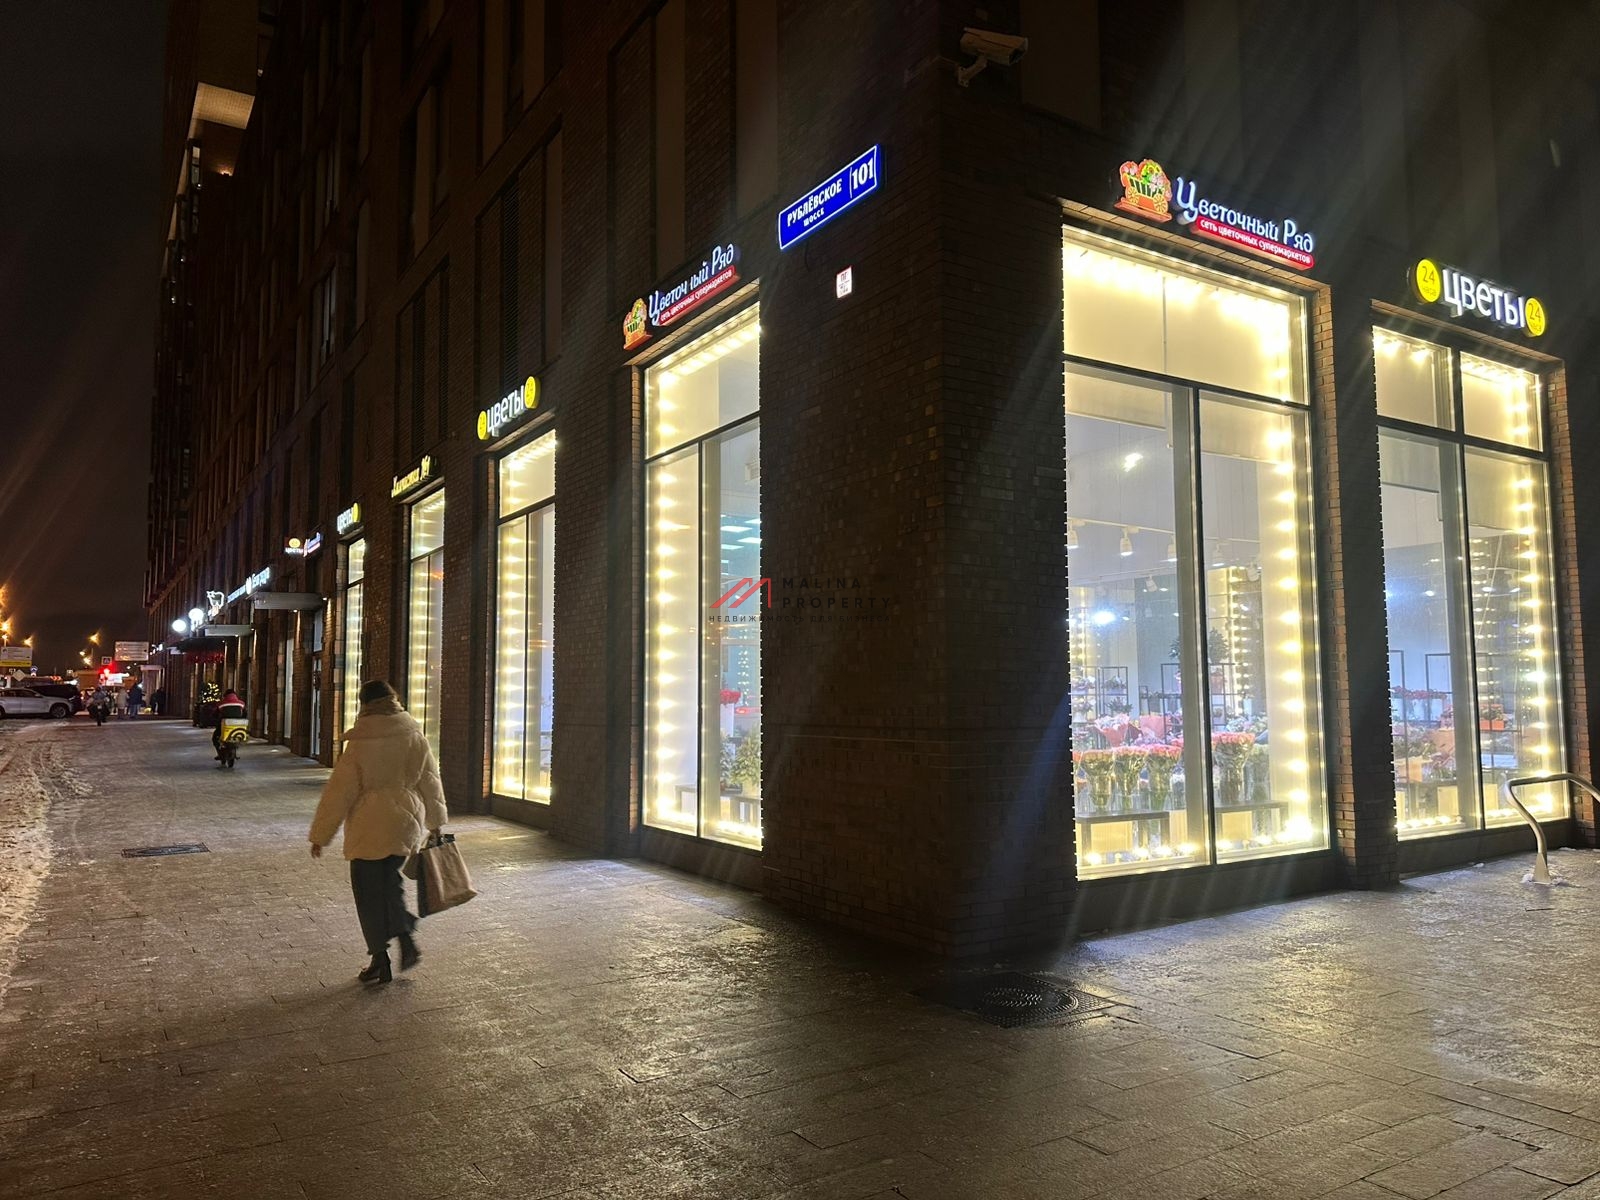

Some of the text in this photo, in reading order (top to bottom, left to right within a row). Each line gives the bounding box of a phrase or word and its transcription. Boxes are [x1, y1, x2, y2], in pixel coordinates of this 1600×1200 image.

[852, 157, 874, 190] 101
[787, 178, 843, 227] РУБЛЁВСКОЕ
[1176, 175, 1314, 253] Цветочный Ряд
[712, 243, 735, 276] Ряд
[1200, 219, 1312, 264] сеть цветочных супермаркетов
[1422, 265, 1435, 285] 24
[1528, 302, 1541, 323] 24
